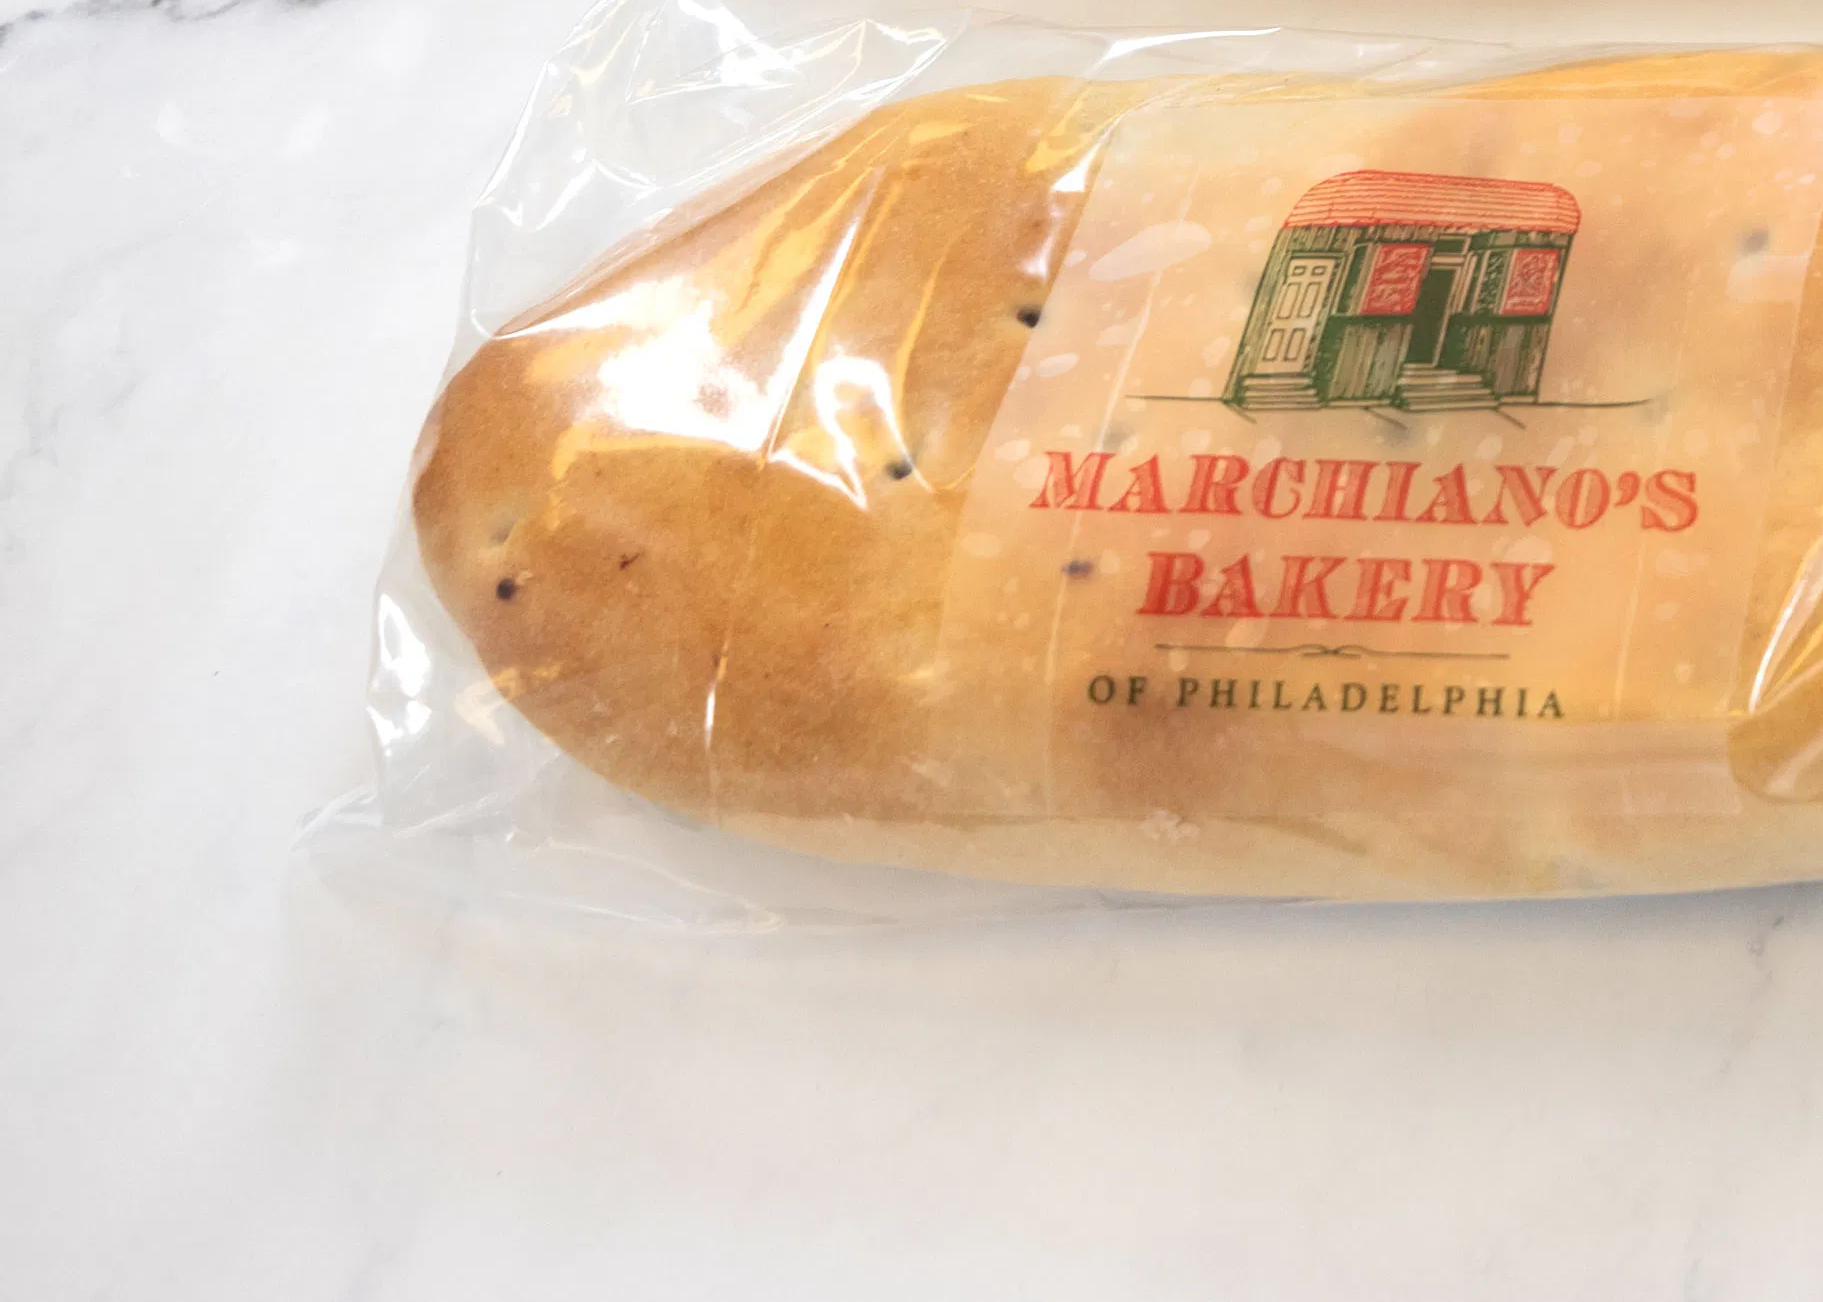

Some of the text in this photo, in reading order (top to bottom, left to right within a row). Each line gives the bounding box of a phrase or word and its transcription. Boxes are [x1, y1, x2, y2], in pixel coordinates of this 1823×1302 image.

[1028, 450, 1699, 531] MARCHIANO'S
[1136, 550, 1556, 626] BAKERY
[1087, 674, 1565, 718] OF PHILADELPHIA
